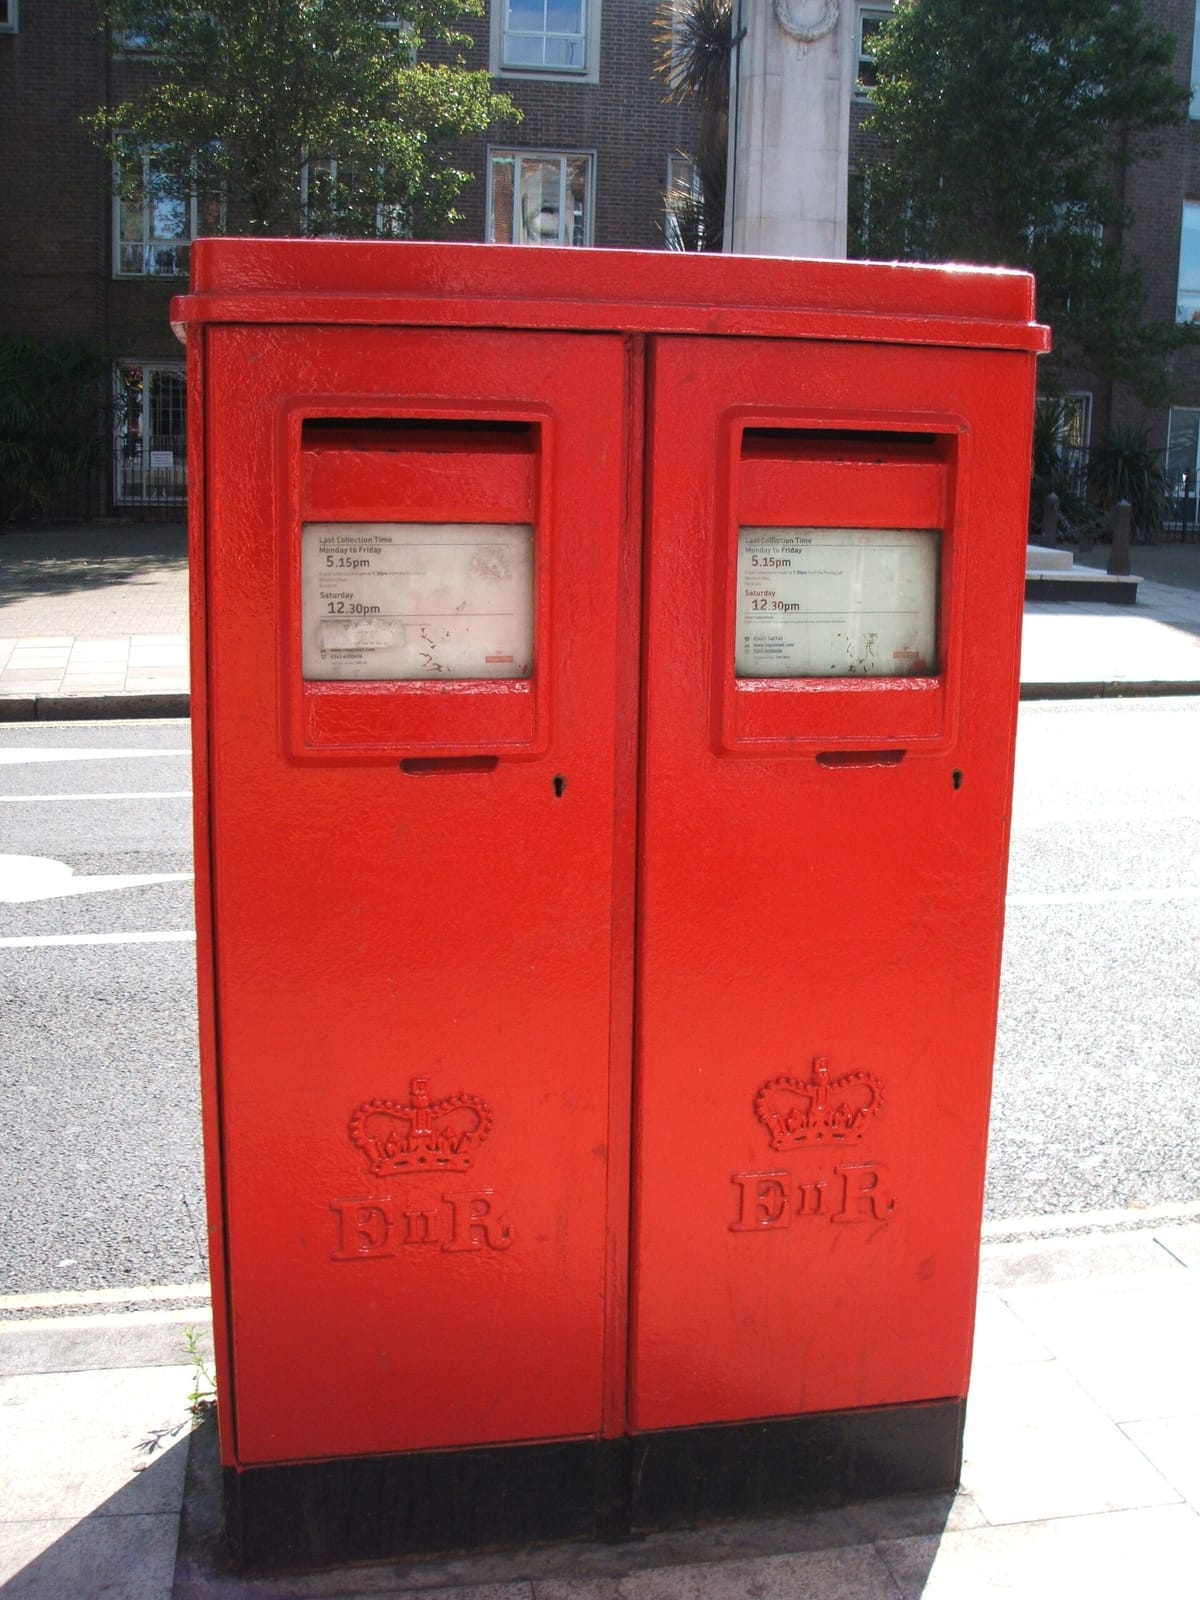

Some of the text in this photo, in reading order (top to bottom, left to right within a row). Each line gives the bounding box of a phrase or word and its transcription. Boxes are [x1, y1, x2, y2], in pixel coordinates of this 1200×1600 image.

[319, 536, 392, 544] Last Collection Time
[744, 536, 812, 545] Last Collection Time
[319, 546, 348, 554] Monday
[359, 546, 382, 554] Friday
[745, 546, 772, 554] Monday
[781, 546, 803, 554] Friday
[326, 555, 370, 569] 5.15pm
[751, 555, 791, 568] 5.15pm
[319, 591, 354, 600] Saturday
[744, 588, 776, 597] Saturday
[327, 601, 381, 615] 12.30pm
[751, 598, 800, 612] 12.30pm
